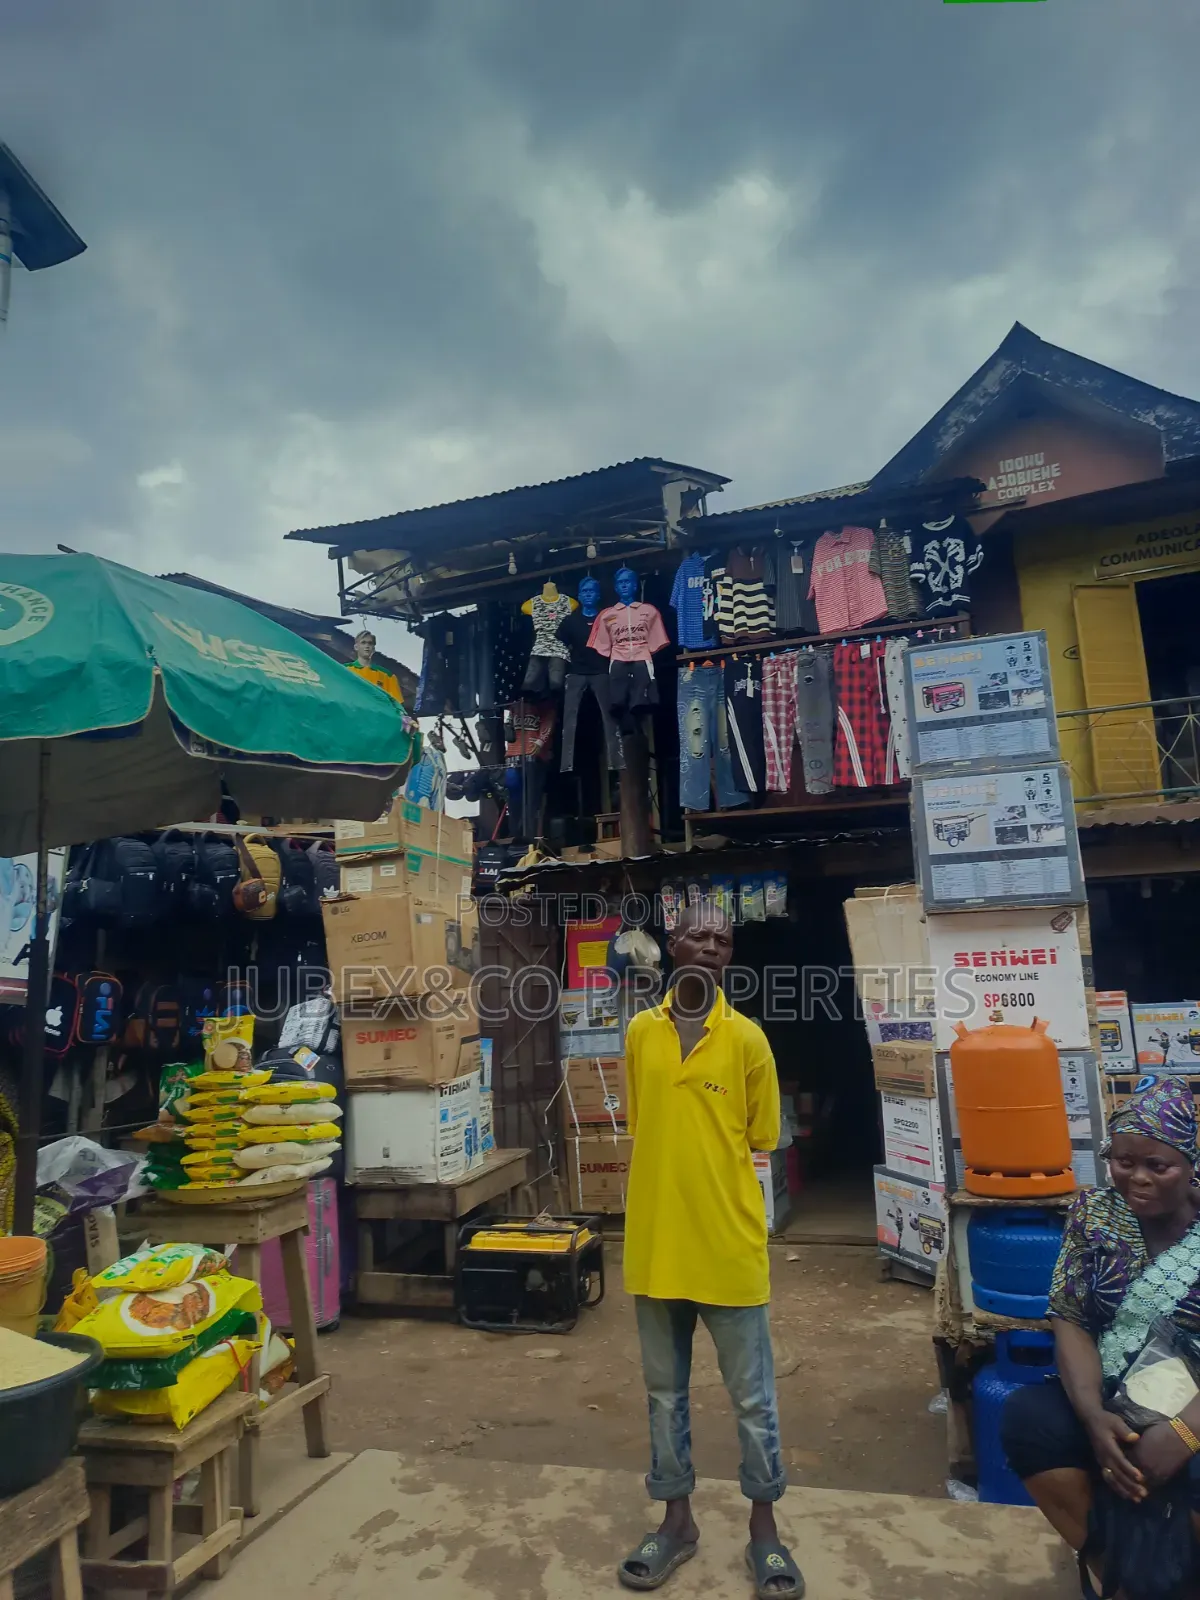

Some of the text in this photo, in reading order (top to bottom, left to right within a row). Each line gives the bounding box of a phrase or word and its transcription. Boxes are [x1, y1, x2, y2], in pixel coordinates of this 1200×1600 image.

[997, 479, 1056, 500] COMPLEX
[350, 930, 388, 944] XBOOM
[954, 947, 1058, 968] SENWEI
[974, 971, 1040, 983] ECONOMY LINE
[984, 992, 1035, 1008] SP6800
[356, 1028, 417, 1044] SUMEC
[579, 1162, 628, 1173] SUMEC
